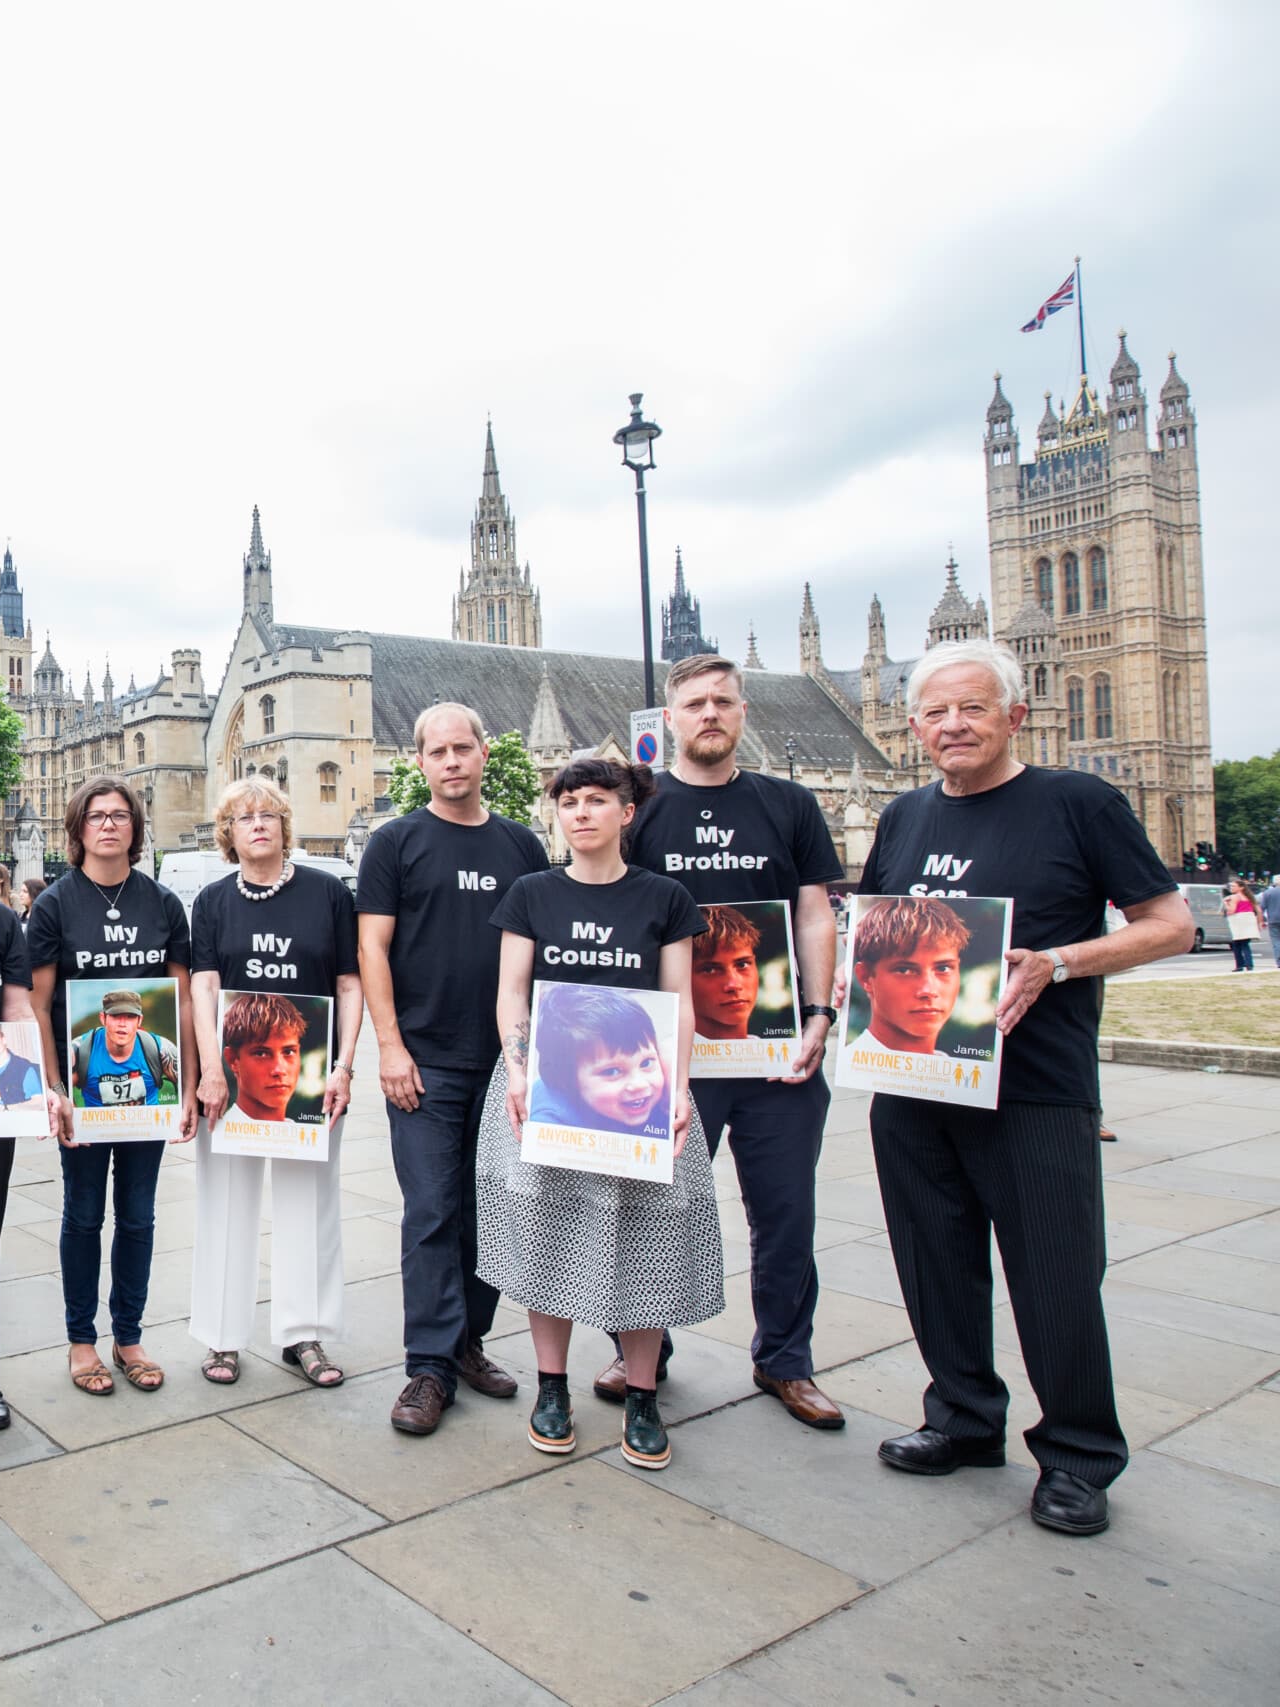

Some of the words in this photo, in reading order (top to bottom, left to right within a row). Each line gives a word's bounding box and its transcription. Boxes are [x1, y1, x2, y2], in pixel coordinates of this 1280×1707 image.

[636, 720, 657, 732] ZONE
[695, 826, 734, 847] My
[665, 852, 769, 872] Brother
[922, 854, 973, 881] My
[457, 870, 497, 891] Me
[103, 925, 138, 945] My
[572, 921, 613, 944] My
[252, 933, 292, 957] My
[76, 948, 166, 969] Partner
[543, 945, 641, 969] Cousin
[245, 959, 297, 979] Son
[763, 1027, 794, 1035] James
[690, 1043, 731, 1056] YONE'S
[953, 1045, 992, 1057] James
[852, 1049, 913, 1071] ANYONE'S
[916, 1056, 951, 1075] CHILD
[113, 1083, 131, 1100] 97
[81, 1109, 126, 1121] ANYONE'S
[298, 1112, 324, 1122] James
[224, 1121, 271, 1136] ANYONE'S
[537, 1127, 596, 1148] ANYONE'S
[643, 1124, 667, 1136] Alan
